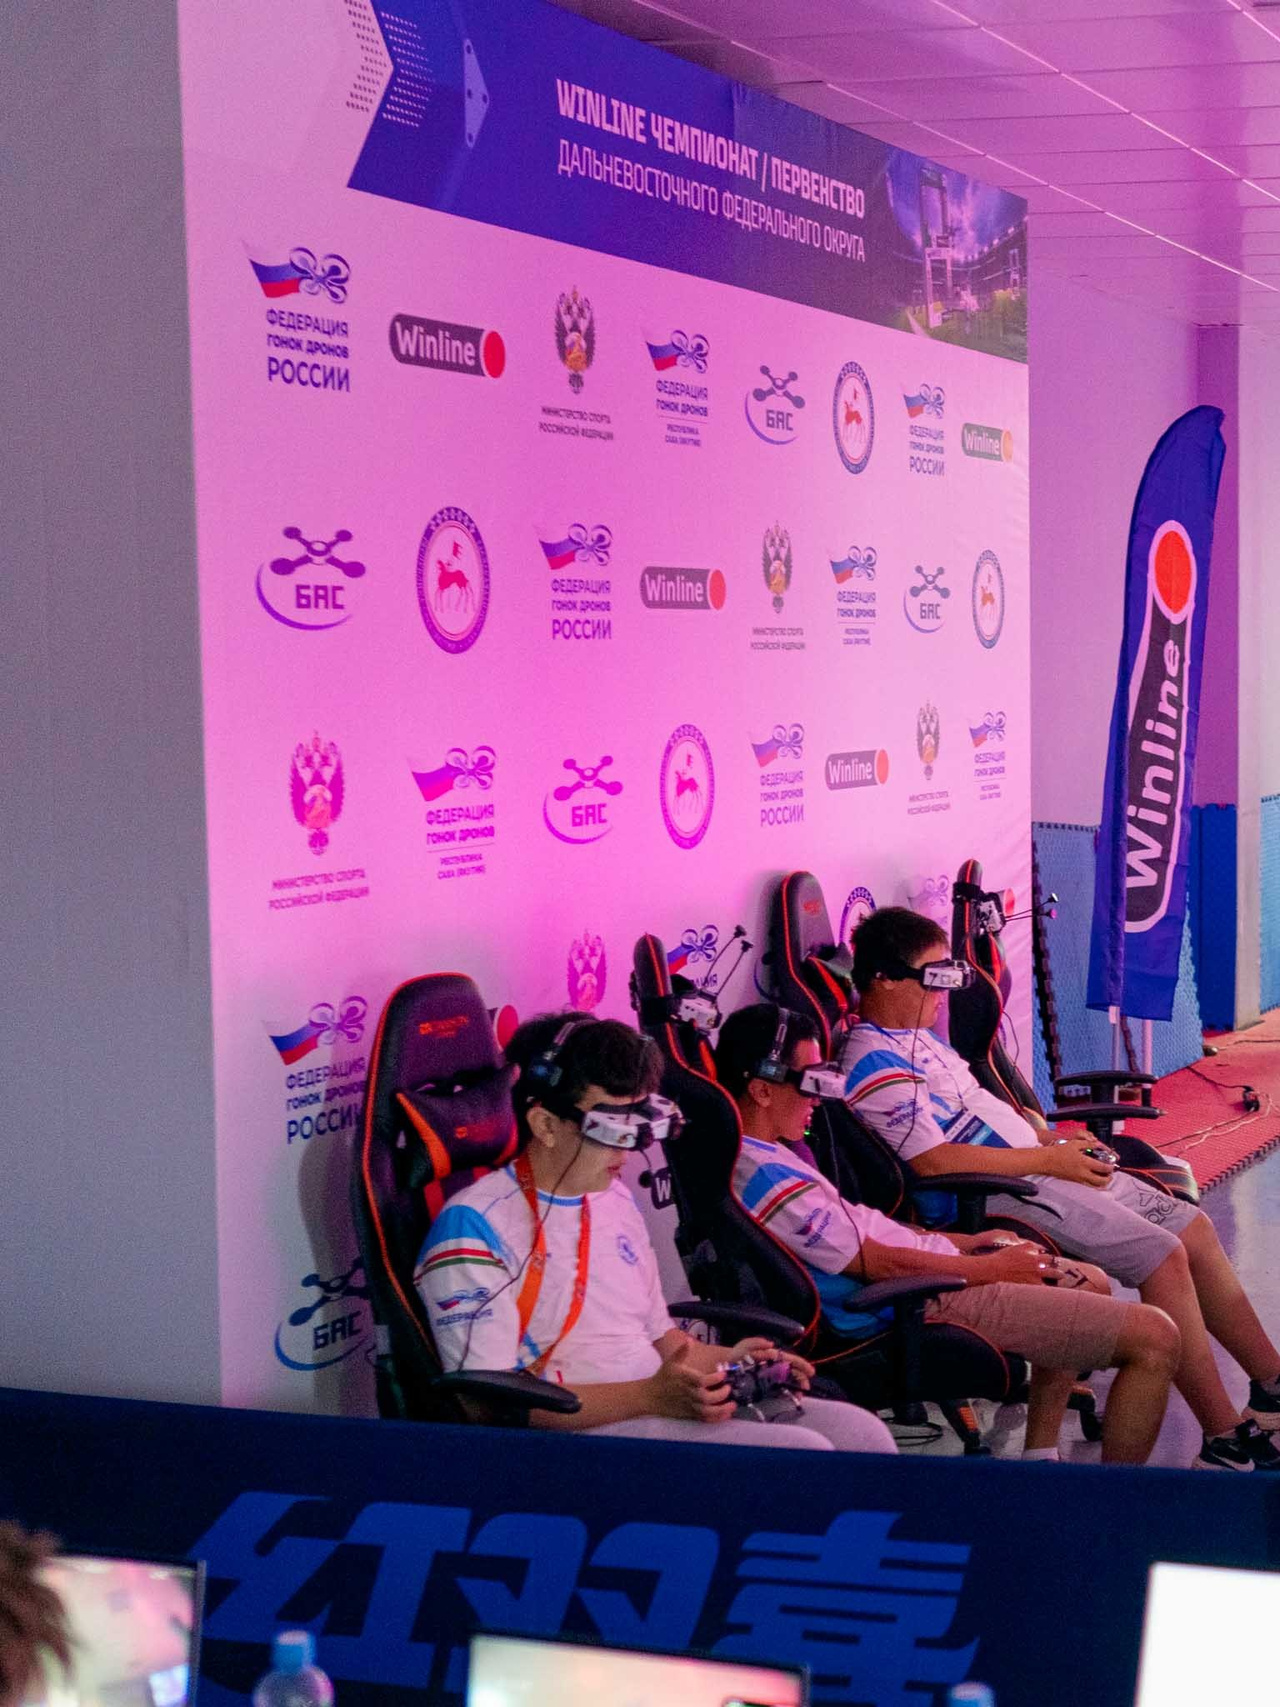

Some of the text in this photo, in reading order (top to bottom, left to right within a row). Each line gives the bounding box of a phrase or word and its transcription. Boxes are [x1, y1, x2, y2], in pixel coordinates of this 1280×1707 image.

[556, 78, 647, 144] WINLINE
[651, 112, 759, 181] ЧЕМПИОНАТ
[771, 157, 865, 219] ПЕРВЕНСТВО
[557, 138, 866, 263] ДАЛЬНЕВОСТОЧНОГО ФЕДЕРАЛЬНОГО ОКРУГА
[266, 308, 348, 338] ФЕДЕРАЦИЯ
[267, 333, 349, 359] ГОНОК ДРОНОВ
[395, 321, 476, 367] Winline
[267, 356, 350, 393] РОССИИ
[656, 379, 708, 400] ФЕДЕРАЦИЯ
[766, 409, 794, 432] БАС
[963, 427, 1000, 456] Winline
[909, 456, 945, 476] РОССИИ
[295, 584, 345, 610] БАС
[551, 578, 612, 596] ФЕДЕРАЦИЯ
[644, 574, 704, 603] Winline
[552, 599, 611, 613] ГОНОК ДРОНОВ
[920, 602, 941, 620] БАС
[552, 618, 612, 641] РОССИИ
[828, 757, 873, 784] Winline
[1125, 640, 1180, 889] Winline
[426, 803, 495, 826] ФЕДЕРАЦИЯ
[571, 803, 608, 828] БАС
[760, 804, 804, 828] РОССИИ
[313, 1310, 363, 1351] БАС
